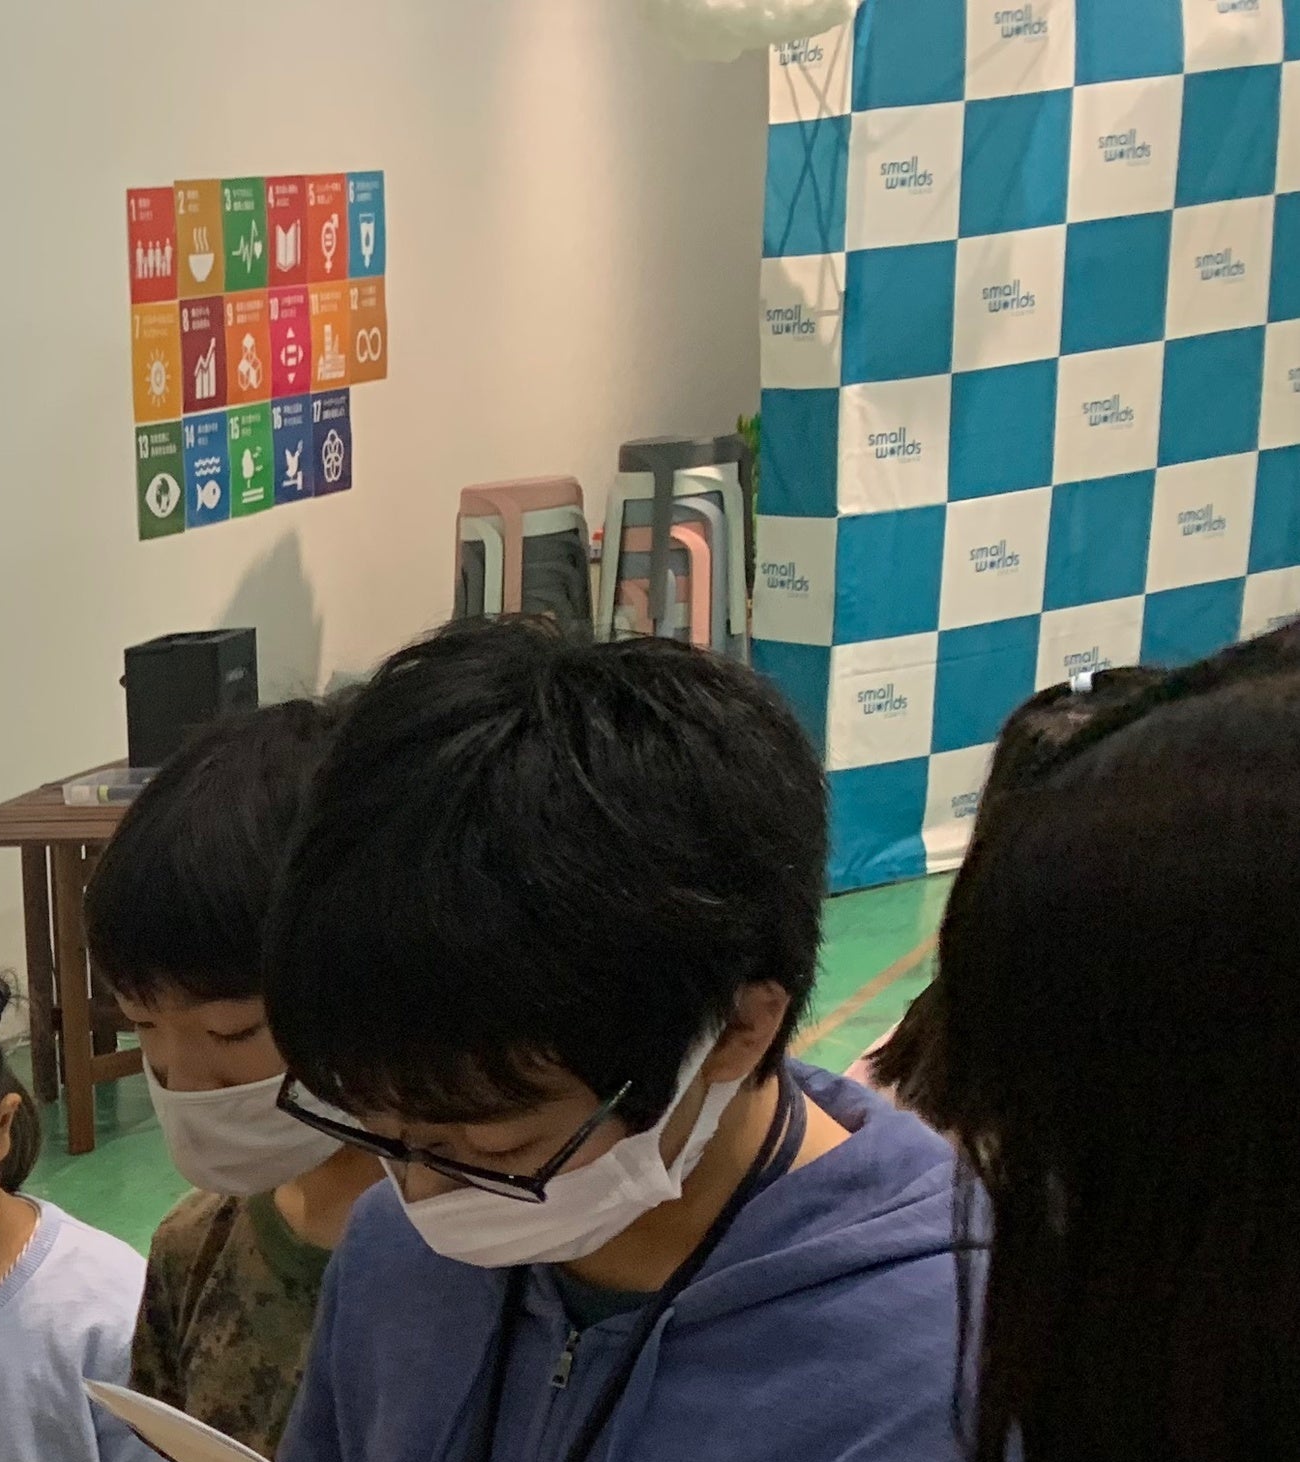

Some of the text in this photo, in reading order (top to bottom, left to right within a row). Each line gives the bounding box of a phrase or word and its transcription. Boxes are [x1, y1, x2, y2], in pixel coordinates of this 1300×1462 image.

[994, 4, 1032, 24] small
[1001, 18, 1048, 39] worlds
[779, 45, 824, 66] worlds
[1098, 128, 1136, 149] small
[1104, 141, 1151, 162] worlds
[880, 155, 918, 176] small
[885, 169, 933, 190] worlds
[178, 189, 185, 215] 2
[224, 187, 232, 211] 3
[268, 185, 274, 208] 4
[308, 182, 316, 206] 5
[349, 180, 355, 203] 6
[130, 198, 136, 221] 1
[1195, 248, 1232, 268] small
[1201, 259, 1245, 280] worlds
[349, 287, 359, 310] 12
[982, 279, 1020, 299] small
[269, 297, 279, 320] 10
[310, 293, 319, 315] 11
[988, 291, 1035, 312] worlds
[182, 307, 190, 332] 8
[226, 302, 234, 326] 9
[766, 304, 801, 321] small
[772, 318, 816, 335] worlds
[313, 400, 321, 423] 17
[1083, 394, 1120, 414] small
[272, 406, 282, 430] 16
[1089, 406, 1134, 427] worlds
[184, 424, 195, 449] 14
[229, 416, 240, 440] 15
[868, 427, 906, 446] small
[138, 434, 149, 459] 13
[876, 440, 921, 459] worlds
[1178, 504, 1213, 524] small
[1183, 515, 1226, 536] worlds
[970, 540, 1006, 560] small
[761, 562, 795, 577] small
[975, 552, 1019, 572] worlds
[767, 576, 809, 592] worlds
[1064, 646, 1099, 666] small
[858, 684, 894, 702] small
[864, 695, 907, 715] worlds
